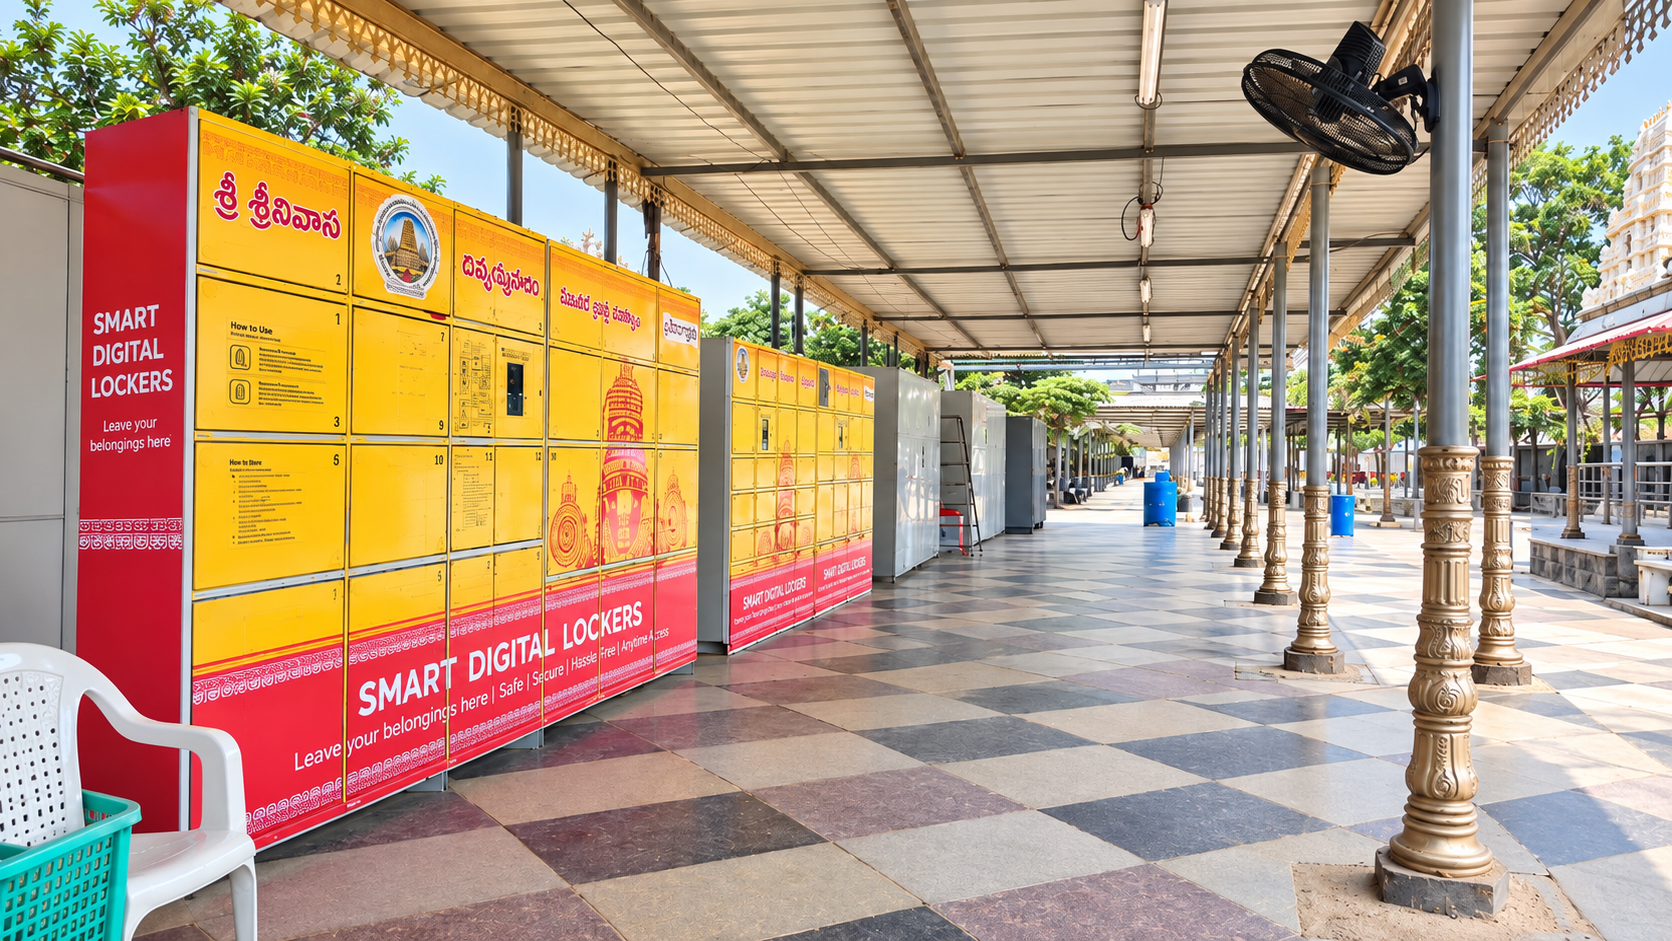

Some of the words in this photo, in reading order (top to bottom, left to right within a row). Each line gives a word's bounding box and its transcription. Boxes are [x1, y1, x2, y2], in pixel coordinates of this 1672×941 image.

[335, 274, 341, 285] 2
[93, 304, 159, 335] SMART
[335, 313, 340, 325] 1
[230, 321, 247, 331] How
[249, 324, 257, 332] to
[259, 326, 273, 335] Use
[92, 338, 164, 367] DIGITAL
[91, 369, 173, 398] LOCKERS
[103, 420, 132, 432] Leave
[134, 418, 157, 433] your
[334, 416, 340, 427] 3
[438, 420, 444, 430] 9
[90, 438, 144, 453] belongings
[147, 435, 171, 448] here
[434, 454, 444, 465] 10
[358, 656, 458, 717] SMART
[469, 629, 555, 682] DIGITAL
[563, 601, 643, 650] LOCKERS
[294, 743, 342, 771] Leave
[347, 729, 379, 757] your
[383, 703, 457, 740] belongings
[461, 693, 488, 713] here
[499, 677, 524, 698] Safe
[532, 665, 564, 686] Secure
[571, 651, 597, 671] Hassle
